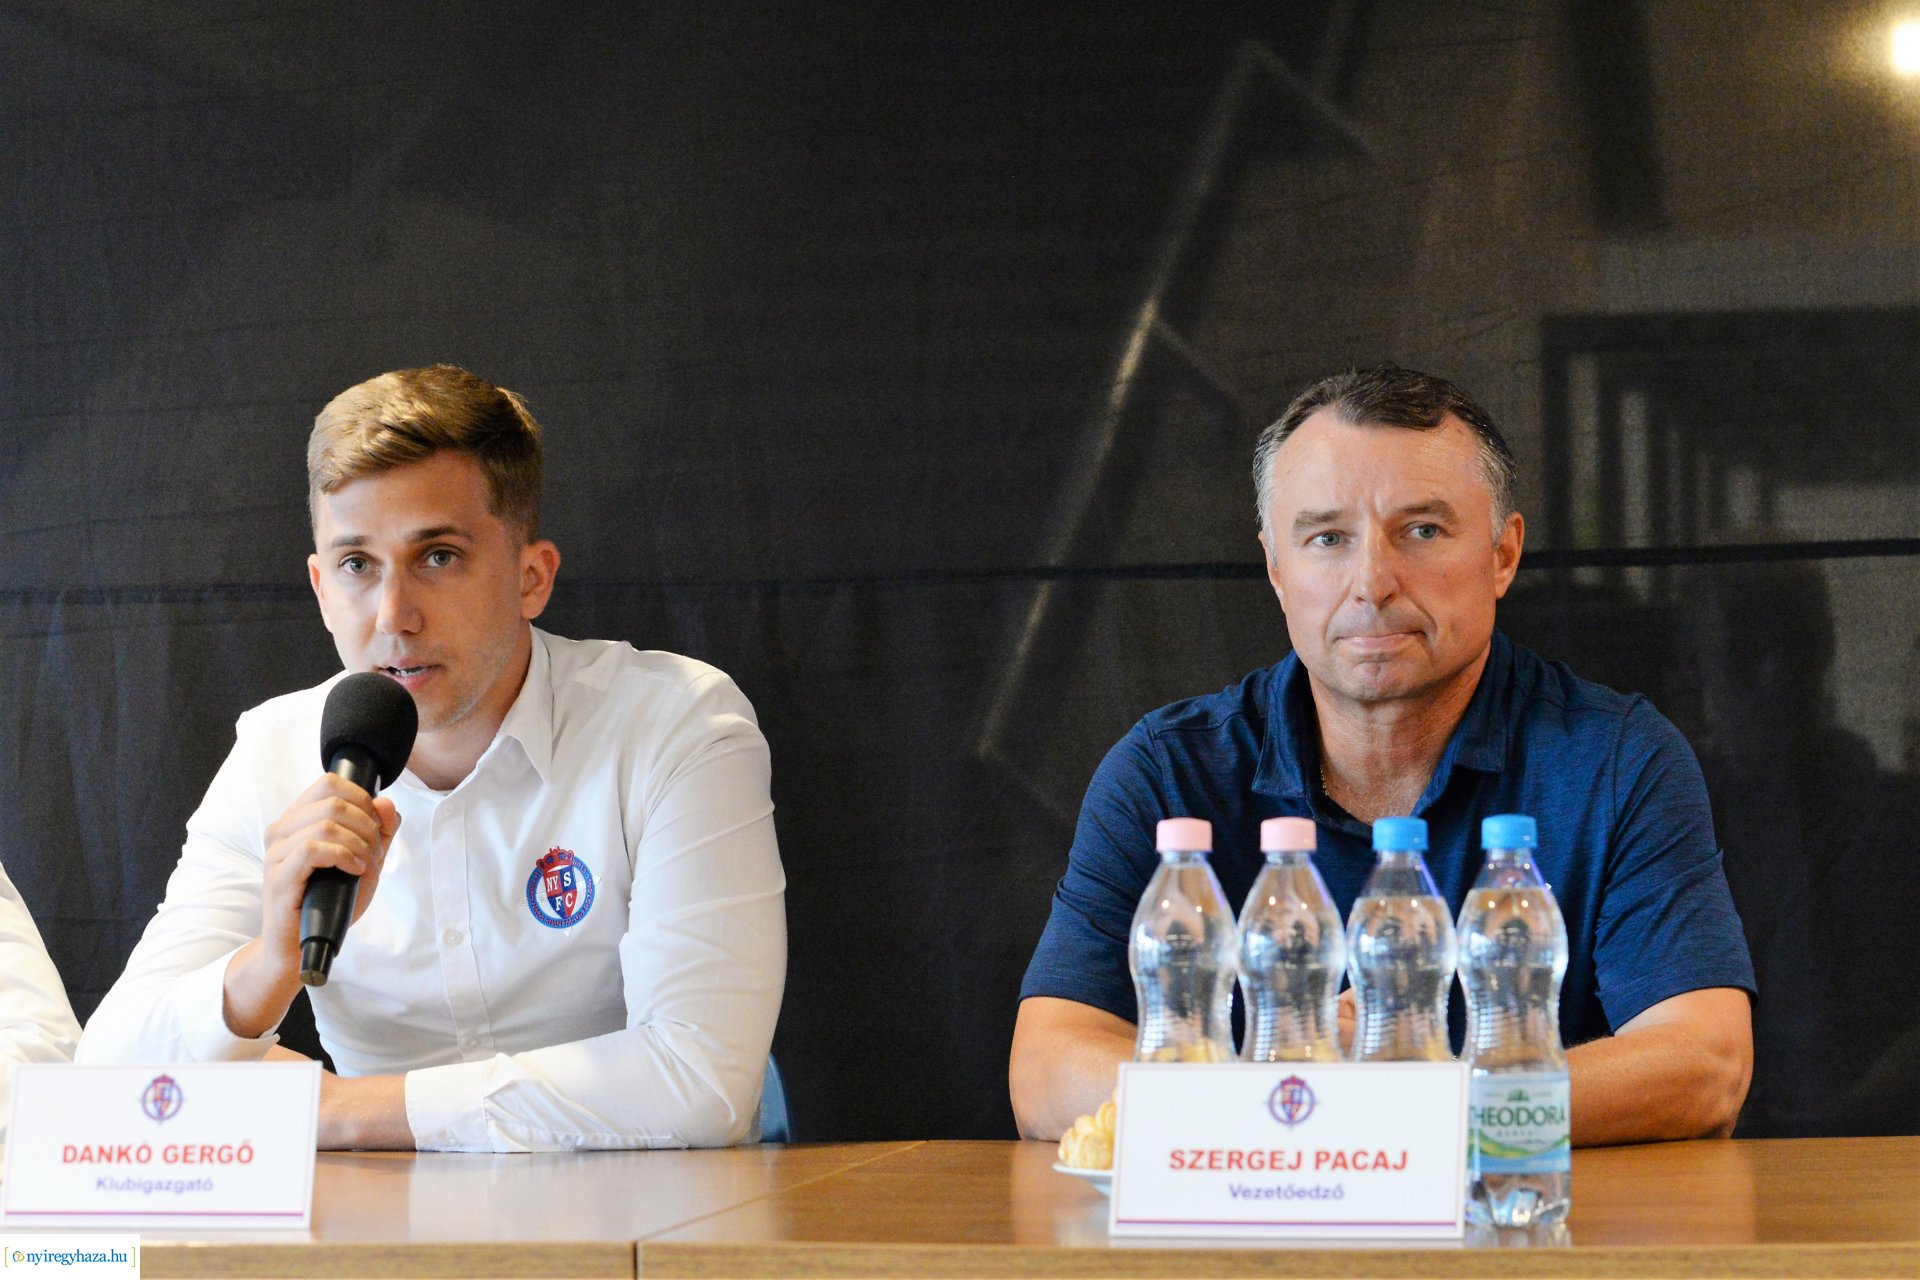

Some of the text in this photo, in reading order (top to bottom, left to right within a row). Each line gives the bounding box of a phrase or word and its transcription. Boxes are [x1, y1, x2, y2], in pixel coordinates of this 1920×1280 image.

[546, 871, 572, 892] NY S
[555, 892, 573, 912] F C
[62, 1139, 254, 1164] DANKÓ GERGŐ
[1169, 1149, 1408, 1171] SZERGEJ PACAJ
[96, 1177, 213, 1194] Klubigazgató
[1228, 1183, 1345, 1200] Vezetőedző
